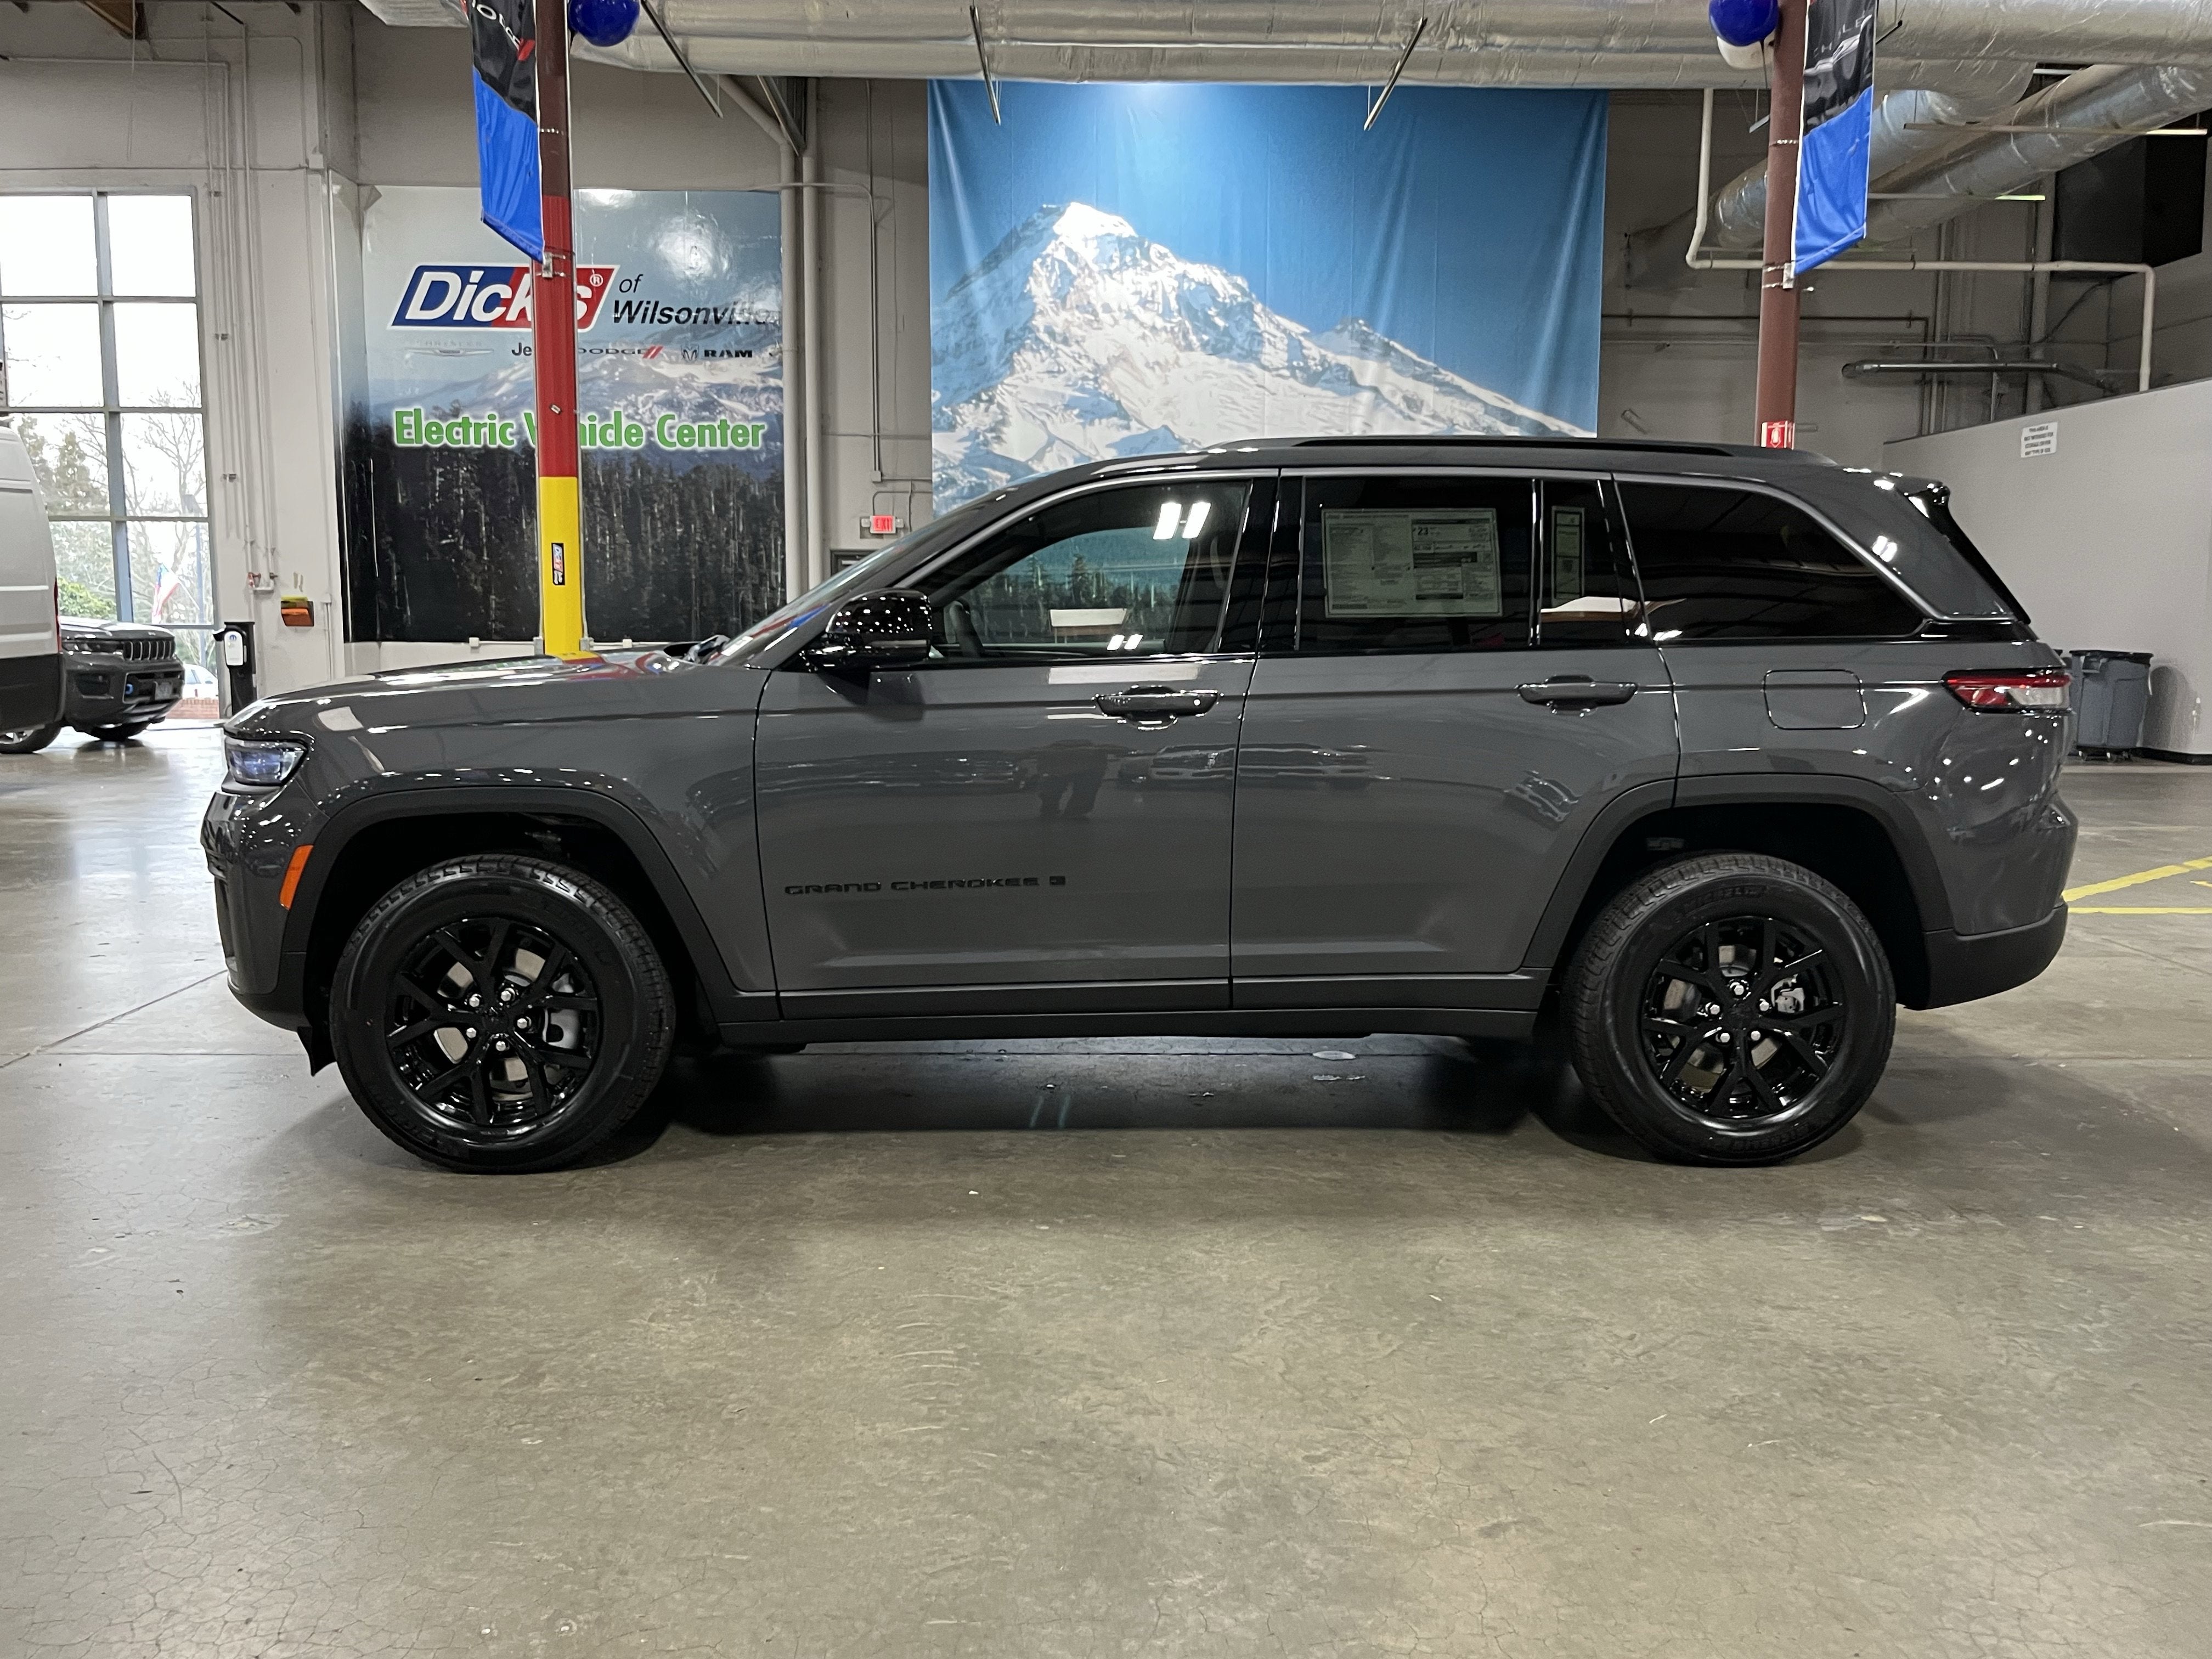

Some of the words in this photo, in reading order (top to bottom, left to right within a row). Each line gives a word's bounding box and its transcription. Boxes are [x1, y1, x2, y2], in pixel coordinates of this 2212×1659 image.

[619, 274, 643, 293] of
[613, 300, 768, 325] Wilsonvi
[511, 342, 532, 356] Je
[703, 349, 753, 358] RAM
[395, 409, 514, 445] Electric
[524, 411, 644, 447] icle
[657, 414, 765, 448] Center
[785, 882, 882, 895] GRAND
[890, 877, 1040, 890] CHEROKEE
